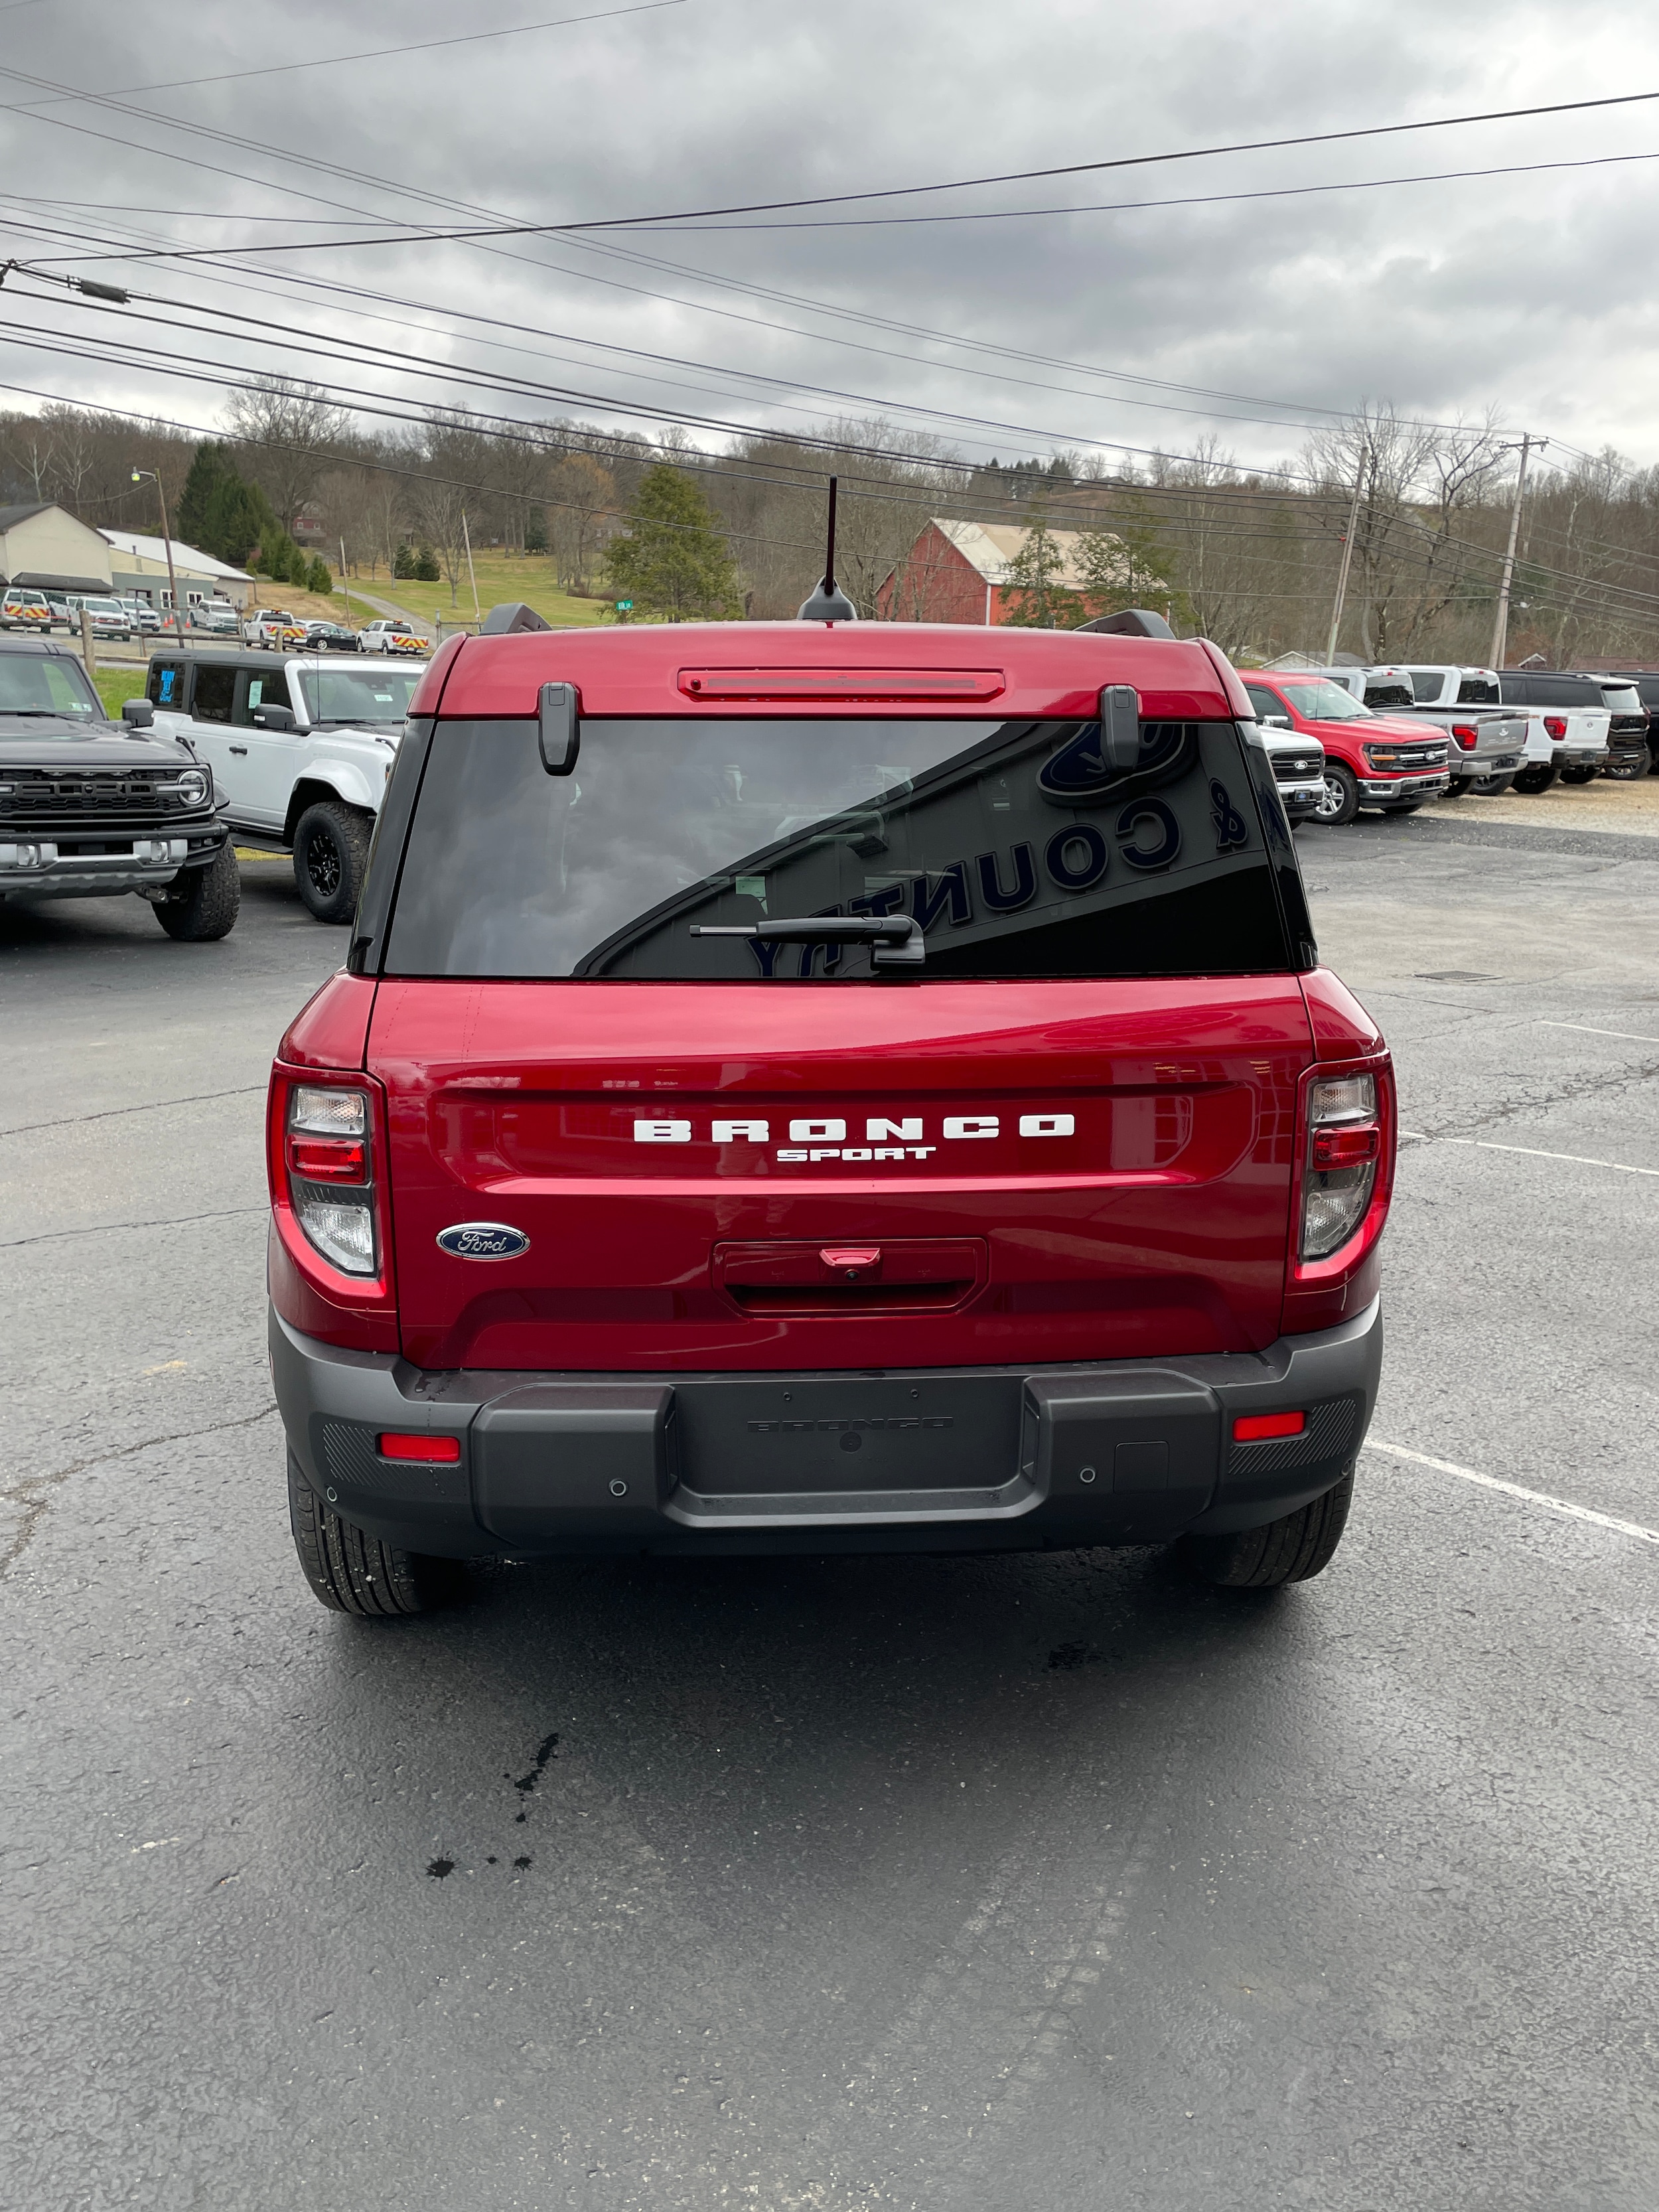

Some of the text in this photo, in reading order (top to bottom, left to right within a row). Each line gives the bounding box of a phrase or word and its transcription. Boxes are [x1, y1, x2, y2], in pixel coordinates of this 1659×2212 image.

[634, 1114, 1075, 1142] BRONCO
[776, 1147, 936, 1162] SPORT
[457, 1231, 508, 1252] Ford
[747, 1416, 954, 1433] BRONCO
